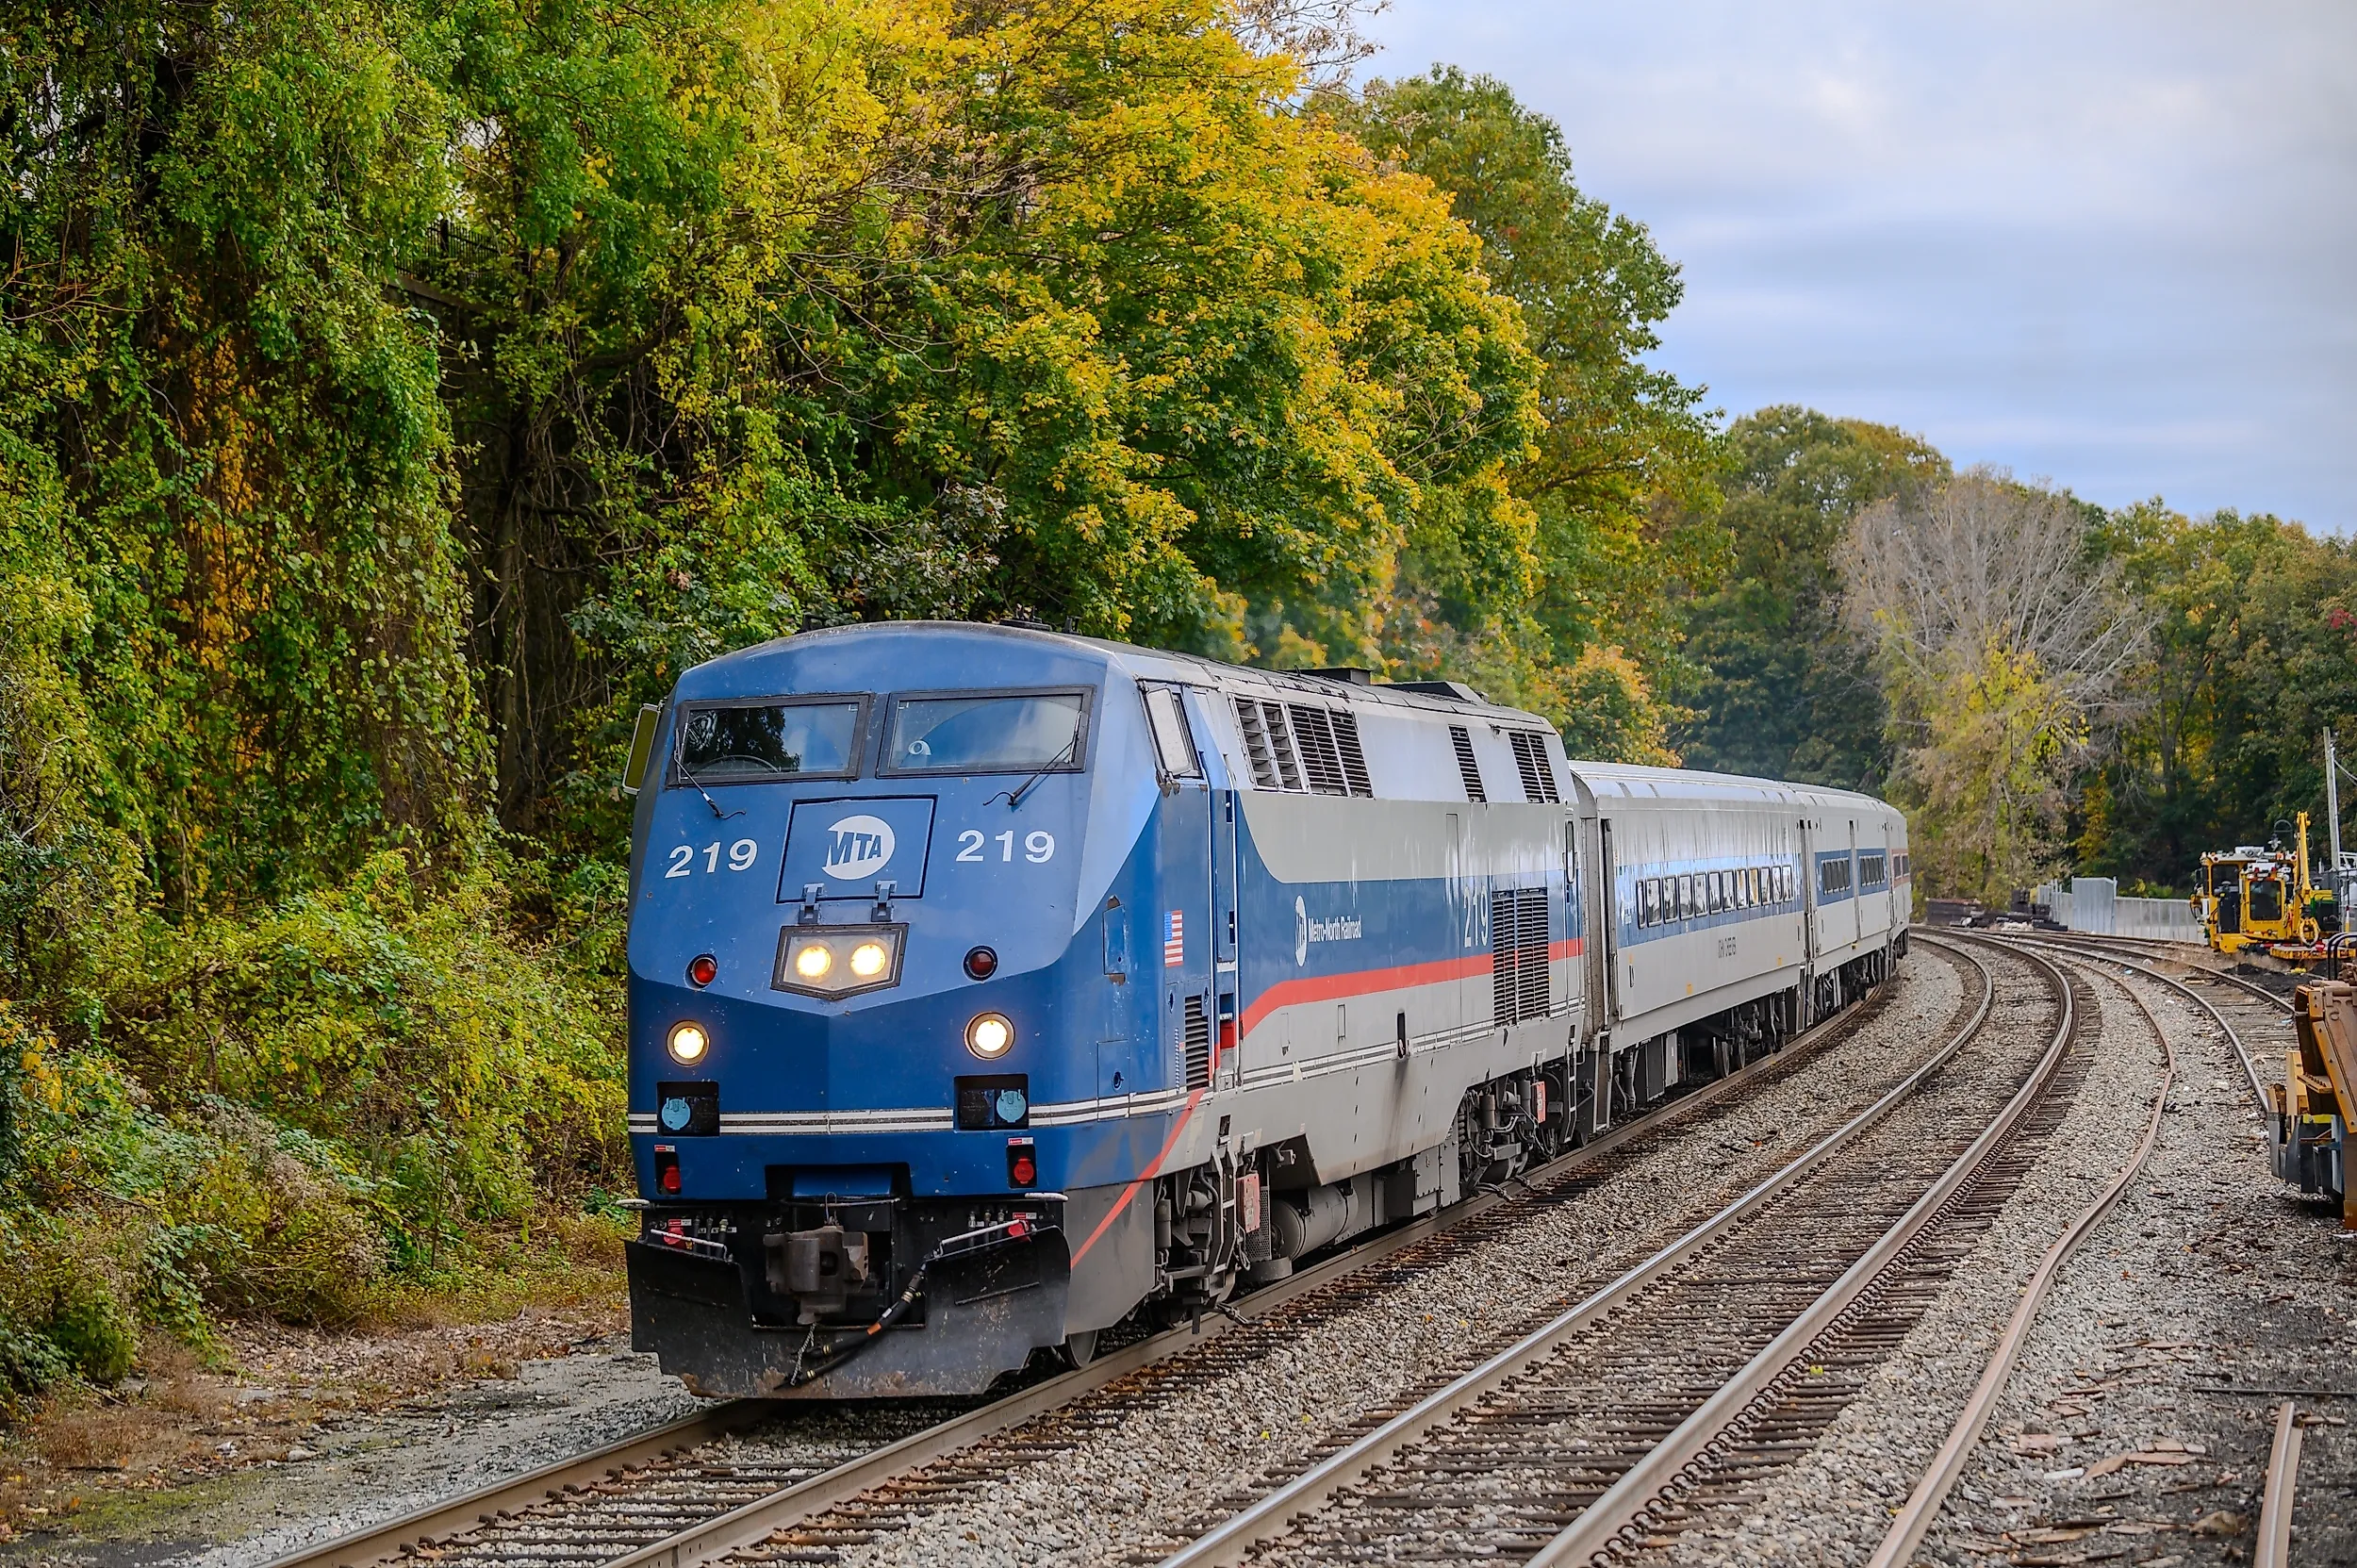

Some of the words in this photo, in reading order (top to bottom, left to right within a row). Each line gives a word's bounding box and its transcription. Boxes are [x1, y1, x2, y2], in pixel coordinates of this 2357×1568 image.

[664, 837, 758, 879] 219
[823, 829, 884, 868] MTA
[955, 829, 1056, 864] 219
[1308, 916, 1340, 943] Metro-North
[1463, 885, 1489, 949] 219
